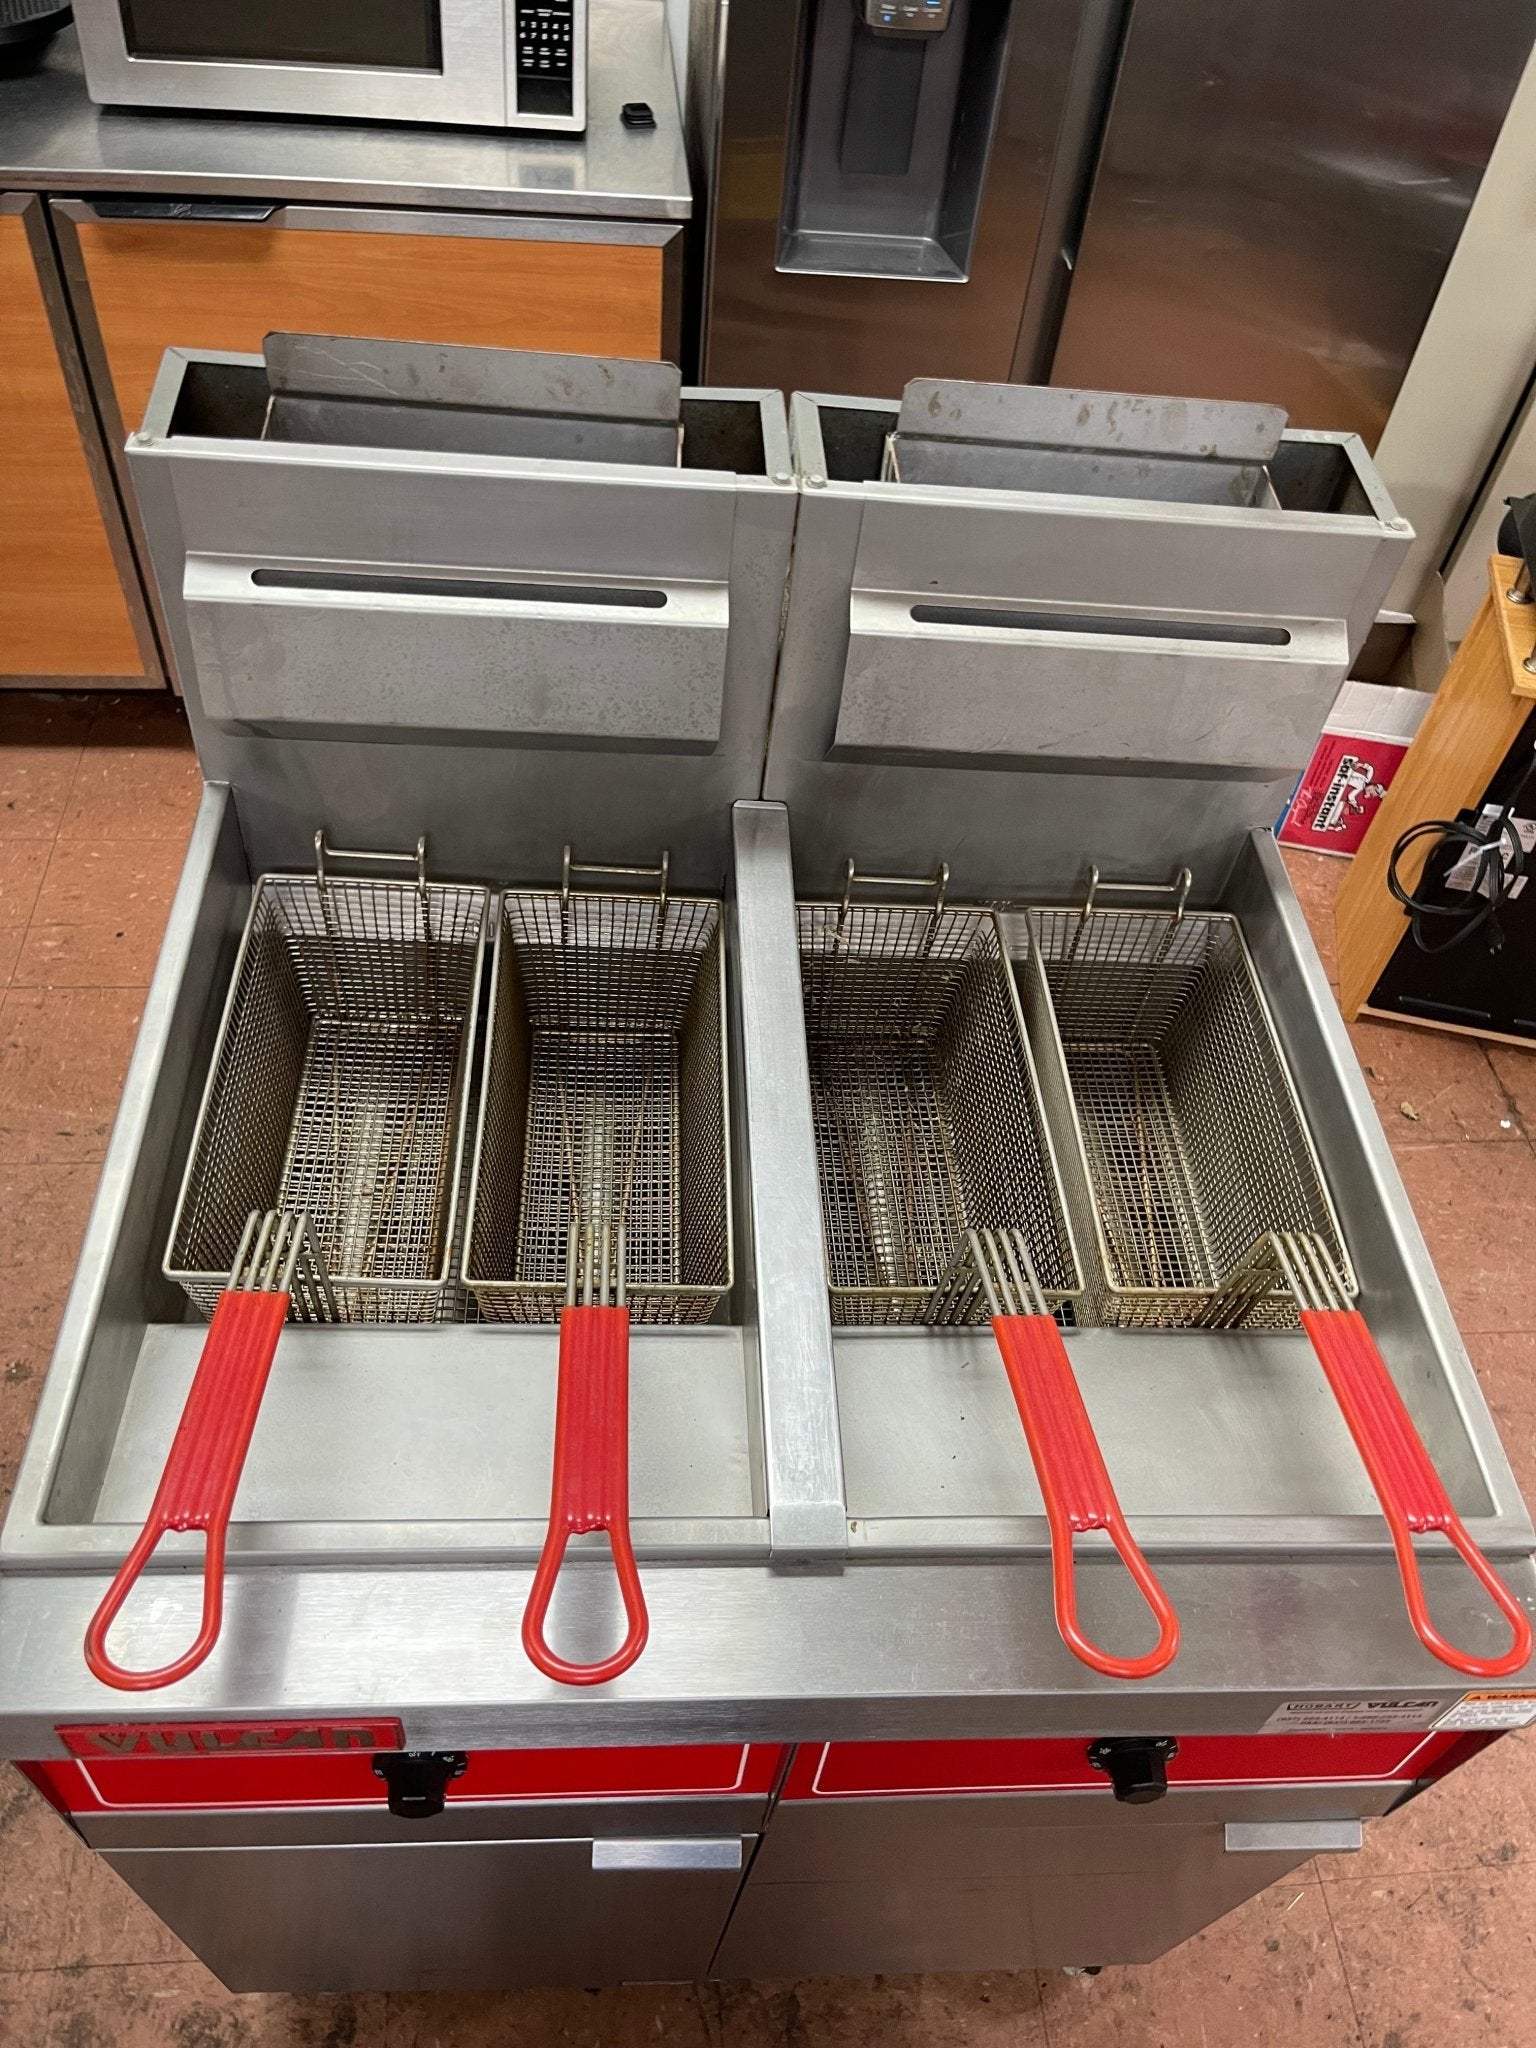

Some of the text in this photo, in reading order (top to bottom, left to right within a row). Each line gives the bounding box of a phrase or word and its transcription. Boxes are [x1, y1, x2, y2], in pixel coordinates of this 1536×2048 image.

[1313, 757, 1355, 830] saf-instant
[1367, 1701, 1439, 1709] VULCAN
[85, 1727, 376, 1755] VULCAN
